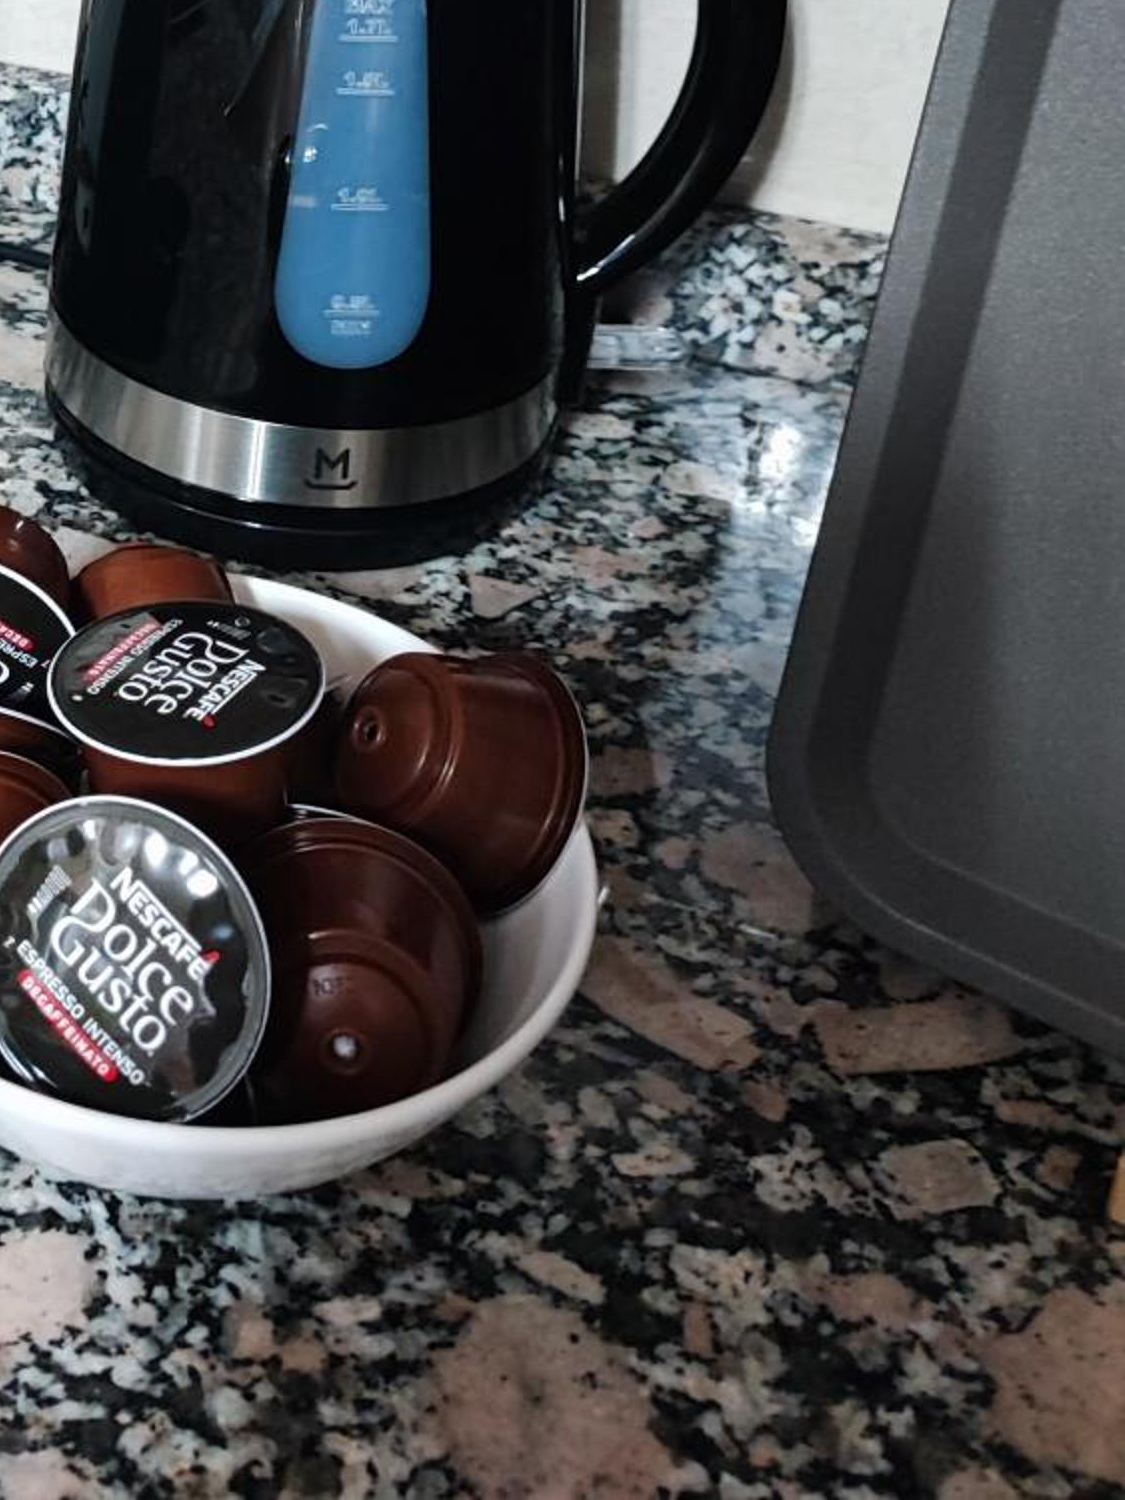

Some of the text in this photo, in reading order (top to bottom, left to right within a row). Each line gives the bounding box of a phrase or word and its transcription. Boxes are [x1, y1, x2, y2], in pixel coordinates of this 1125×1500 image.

[144, 640, 250, 714] Dolce
[16, 939, 85, 1018] ESPRESSO
[82, 1016, 144, 1085] INTENSO
[70, 878, 194, 1026] Dolce
[23, 978, 110, 1076] DECAFFEINATO
